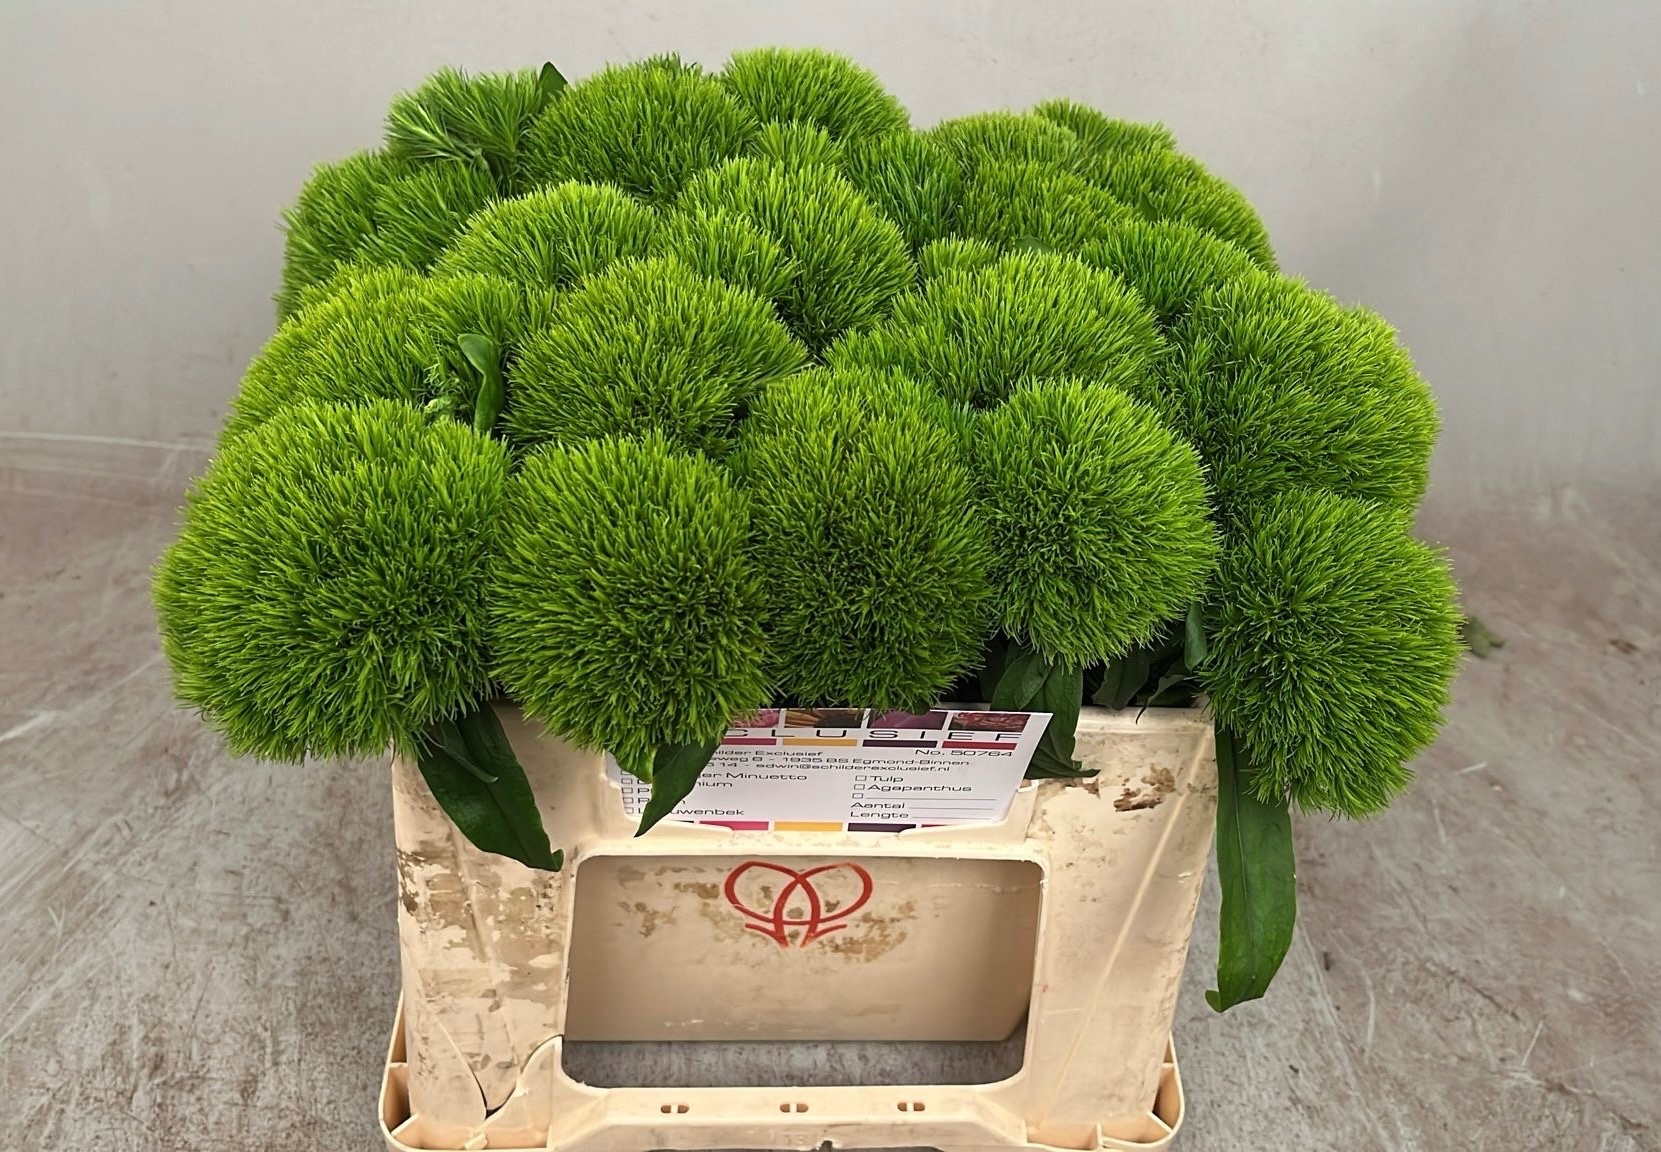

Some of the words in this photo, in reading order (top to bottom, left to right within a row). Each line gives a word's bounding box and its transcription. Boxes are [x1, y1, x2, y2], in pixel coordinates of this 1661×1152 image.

[724, 728, 1022, 741] CLUSIEF
[853, 758, 970, 766] Egmond-Binnen
[726, 772, 808, 780] Minuetto
[869, 775, 904, 783] Tulp
[867, 784, 972, 792] Agapanthus
[850, 811, 909, 819] Lengte
